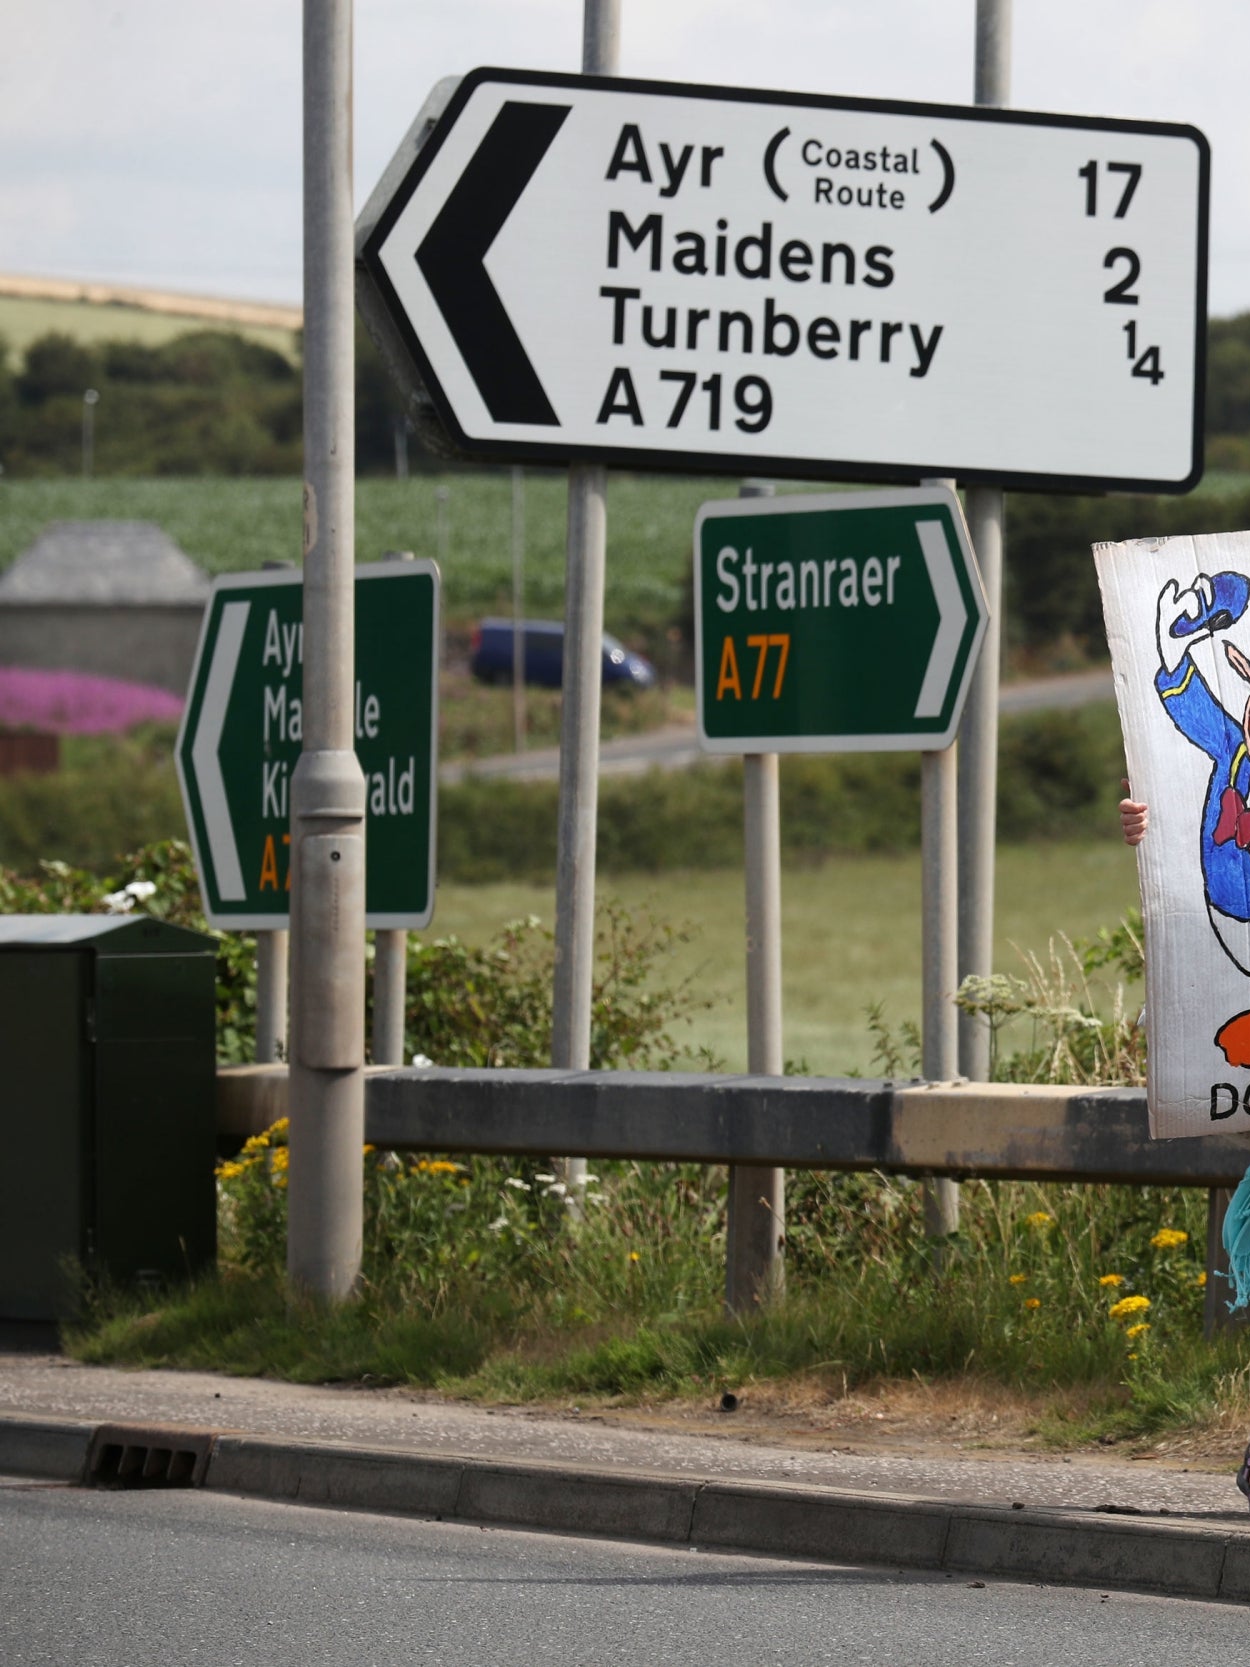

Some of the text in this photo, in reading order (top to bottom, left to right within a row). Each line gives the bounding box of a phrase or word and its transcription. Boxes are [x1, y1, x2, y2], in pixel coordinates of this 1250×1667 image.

[605, 123, 724, 198] Ayr
[1079, 160, 1143, 219] 17
[605, 211, 1141, 305] Maidens 2
[599, 286, 944, 378] Turnberry
[716, 546, 901, 612] Stranraer
[716, 633, 791, 700] A77
[263, 680, 380, 741] Male
